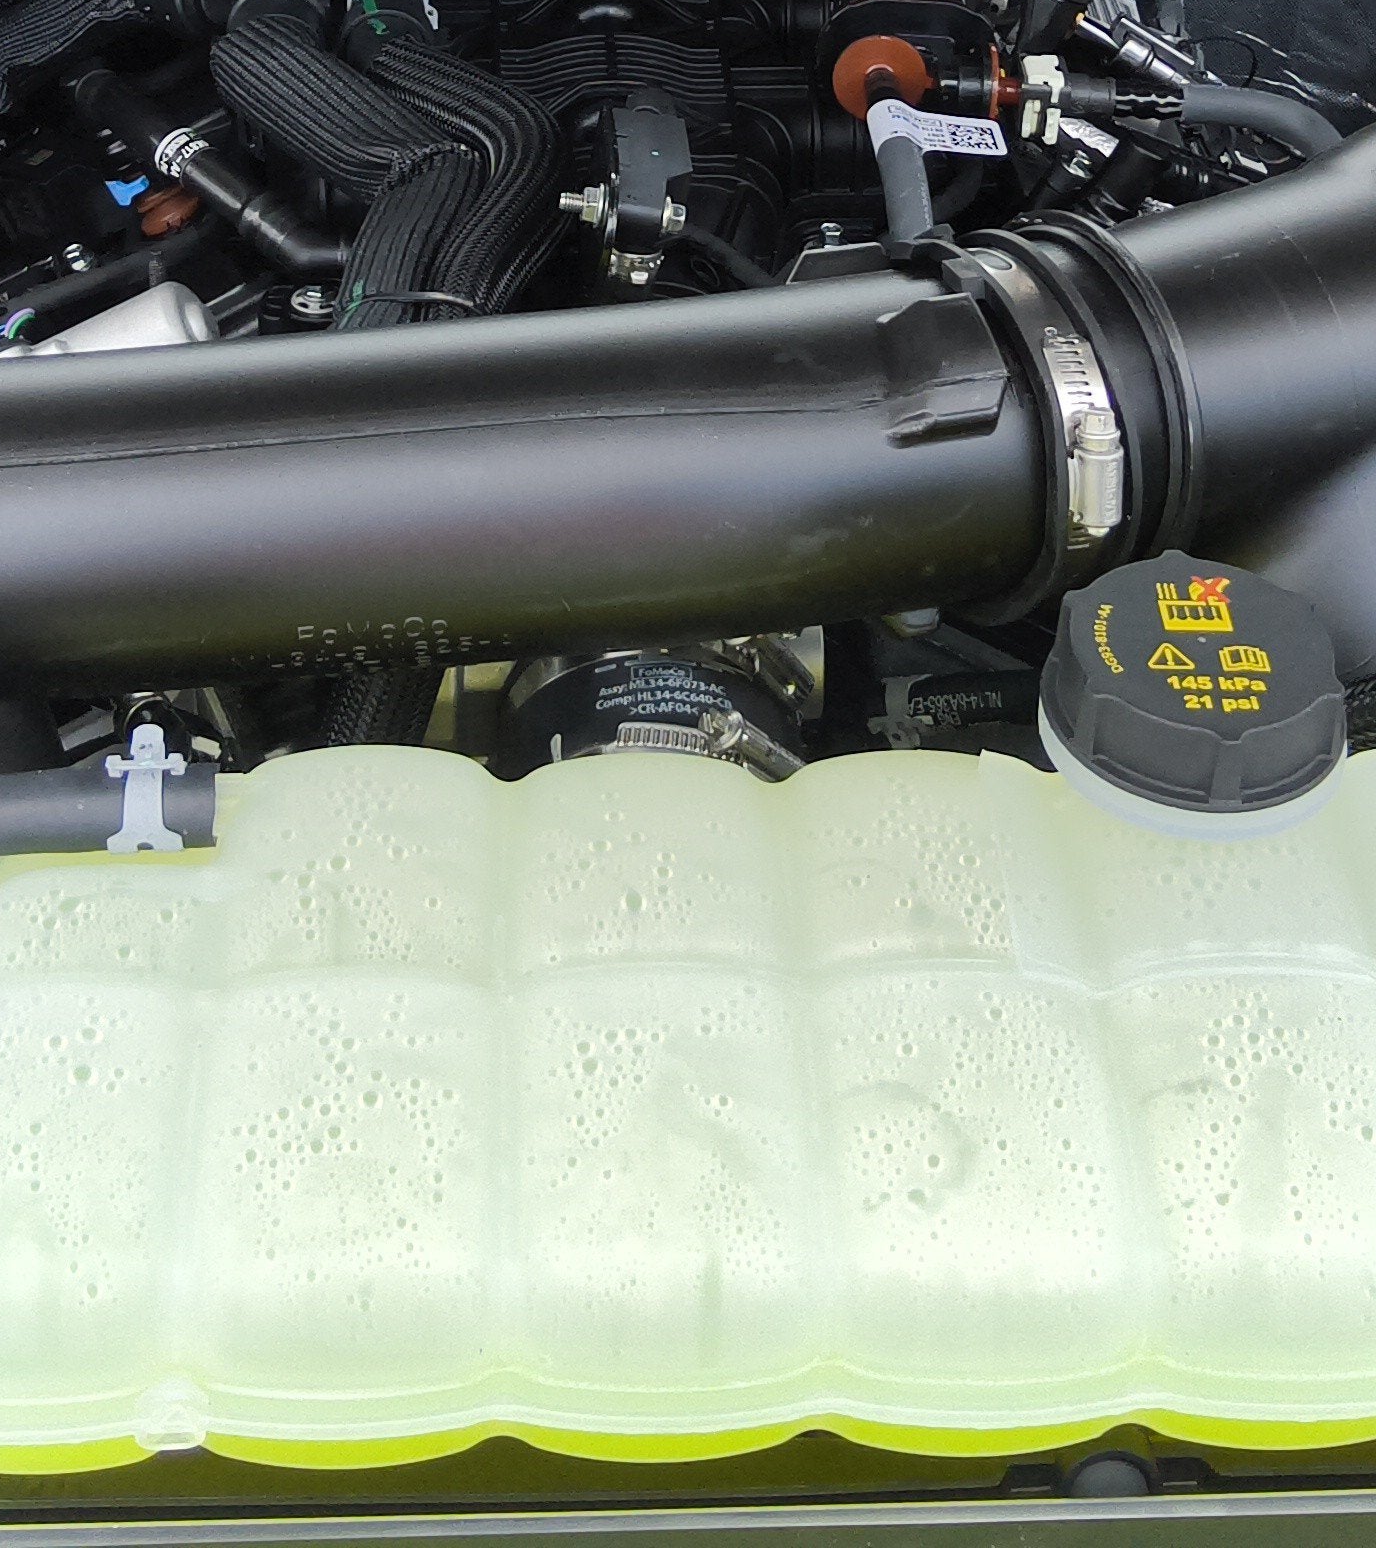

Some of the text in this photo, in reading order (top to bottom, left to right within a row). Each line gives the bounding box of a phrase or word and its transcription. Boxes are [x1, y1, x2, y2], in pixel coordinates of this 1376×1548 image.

[1166, 675, 1268, 693] 145 kPa
[1183, 694, 1260, 713] 21 psi
